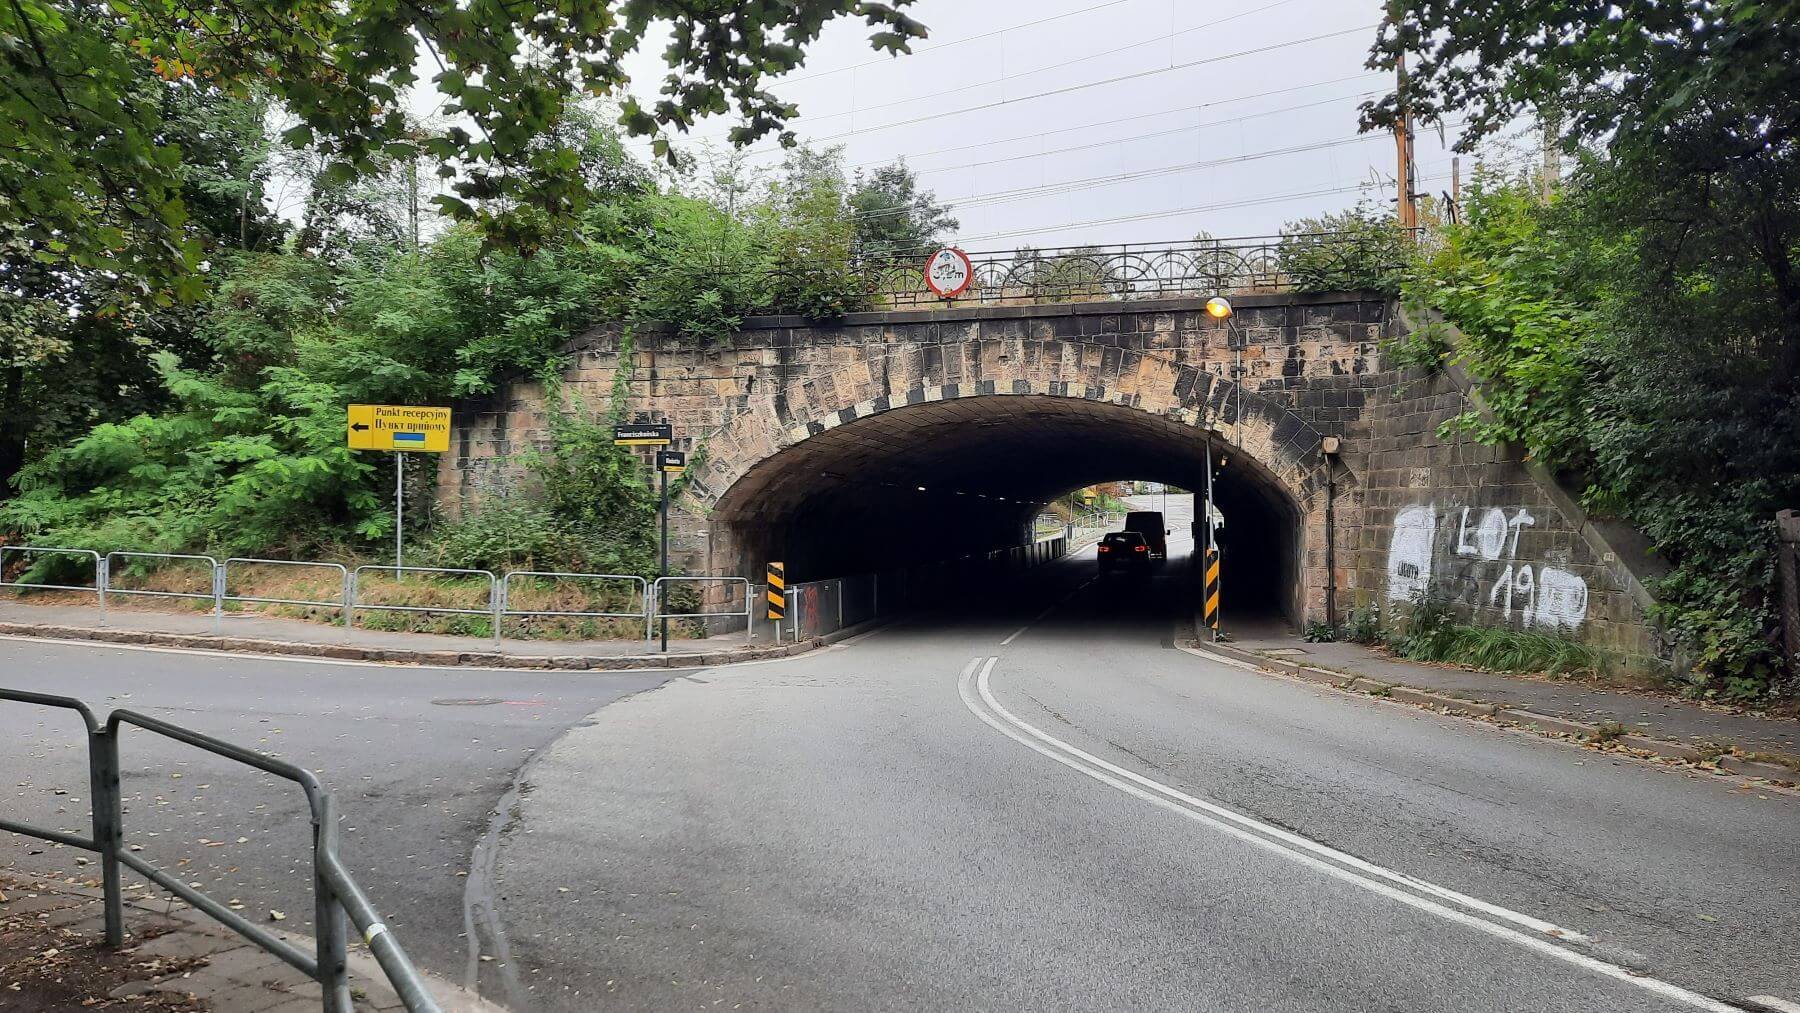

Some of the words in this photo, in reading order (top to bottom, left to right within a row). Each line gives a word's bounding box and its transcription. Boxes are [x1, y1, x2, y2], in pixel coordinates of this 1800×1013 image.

[376, 407, 400, 417] Punkt
[403, 410, 448, 420] recepcyjny
[375, 418, 404, 431] Пункт
